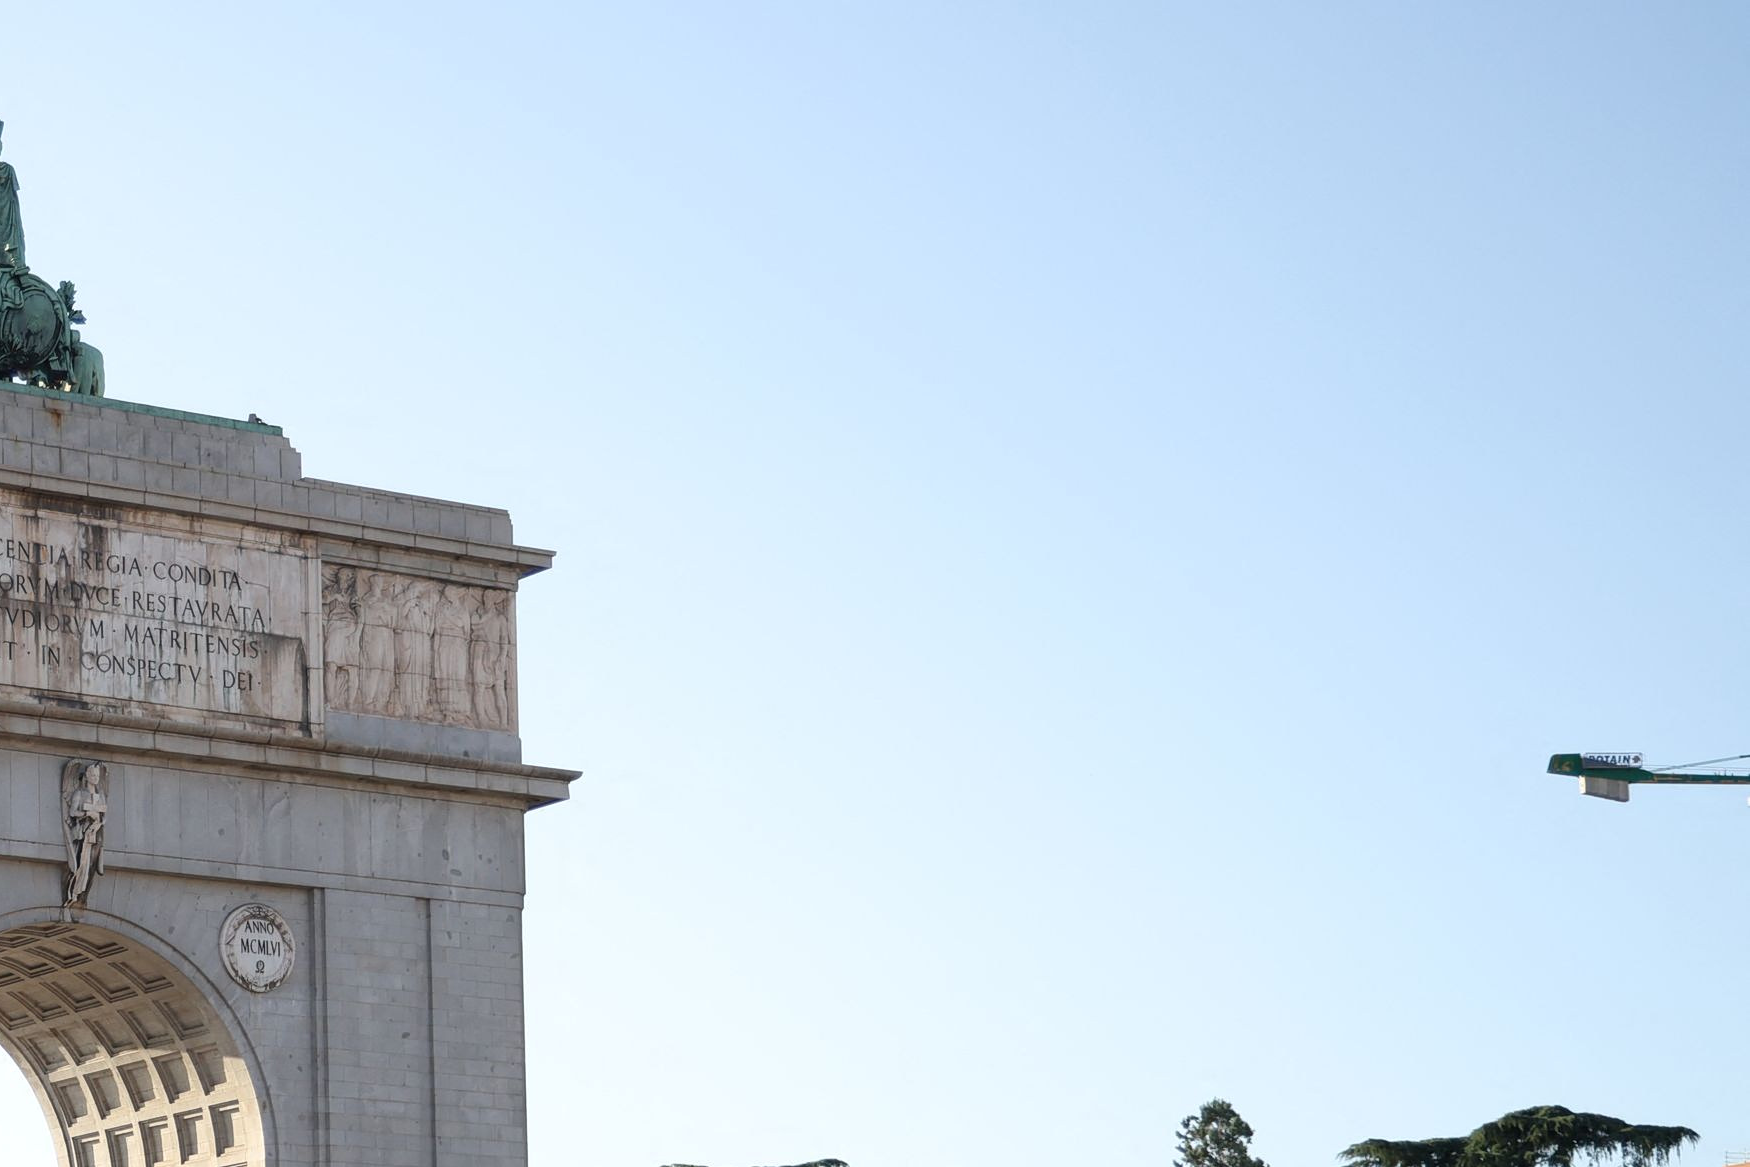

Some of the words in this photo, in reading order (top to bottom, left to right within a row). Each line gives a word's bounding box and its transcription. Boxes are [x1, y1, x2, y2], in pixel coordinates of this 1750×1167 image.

[81, 550, 142, 577] REGIA
[153, 562, 242, 591] CONDITA
[70, 582, 121, 607] DVCE
[133, 591, 266, 634] RESTAVRATA
[124, 623, 259, 659] MATRITENSIS
[42, 645, 61, 665] IN
[81, 651, 202, 685] CONSPECTV
[223, 669, 252, 691] DEI
[245, 921, 274, 935] ANNO
[240, 938, 280, 957] MCMLVI
